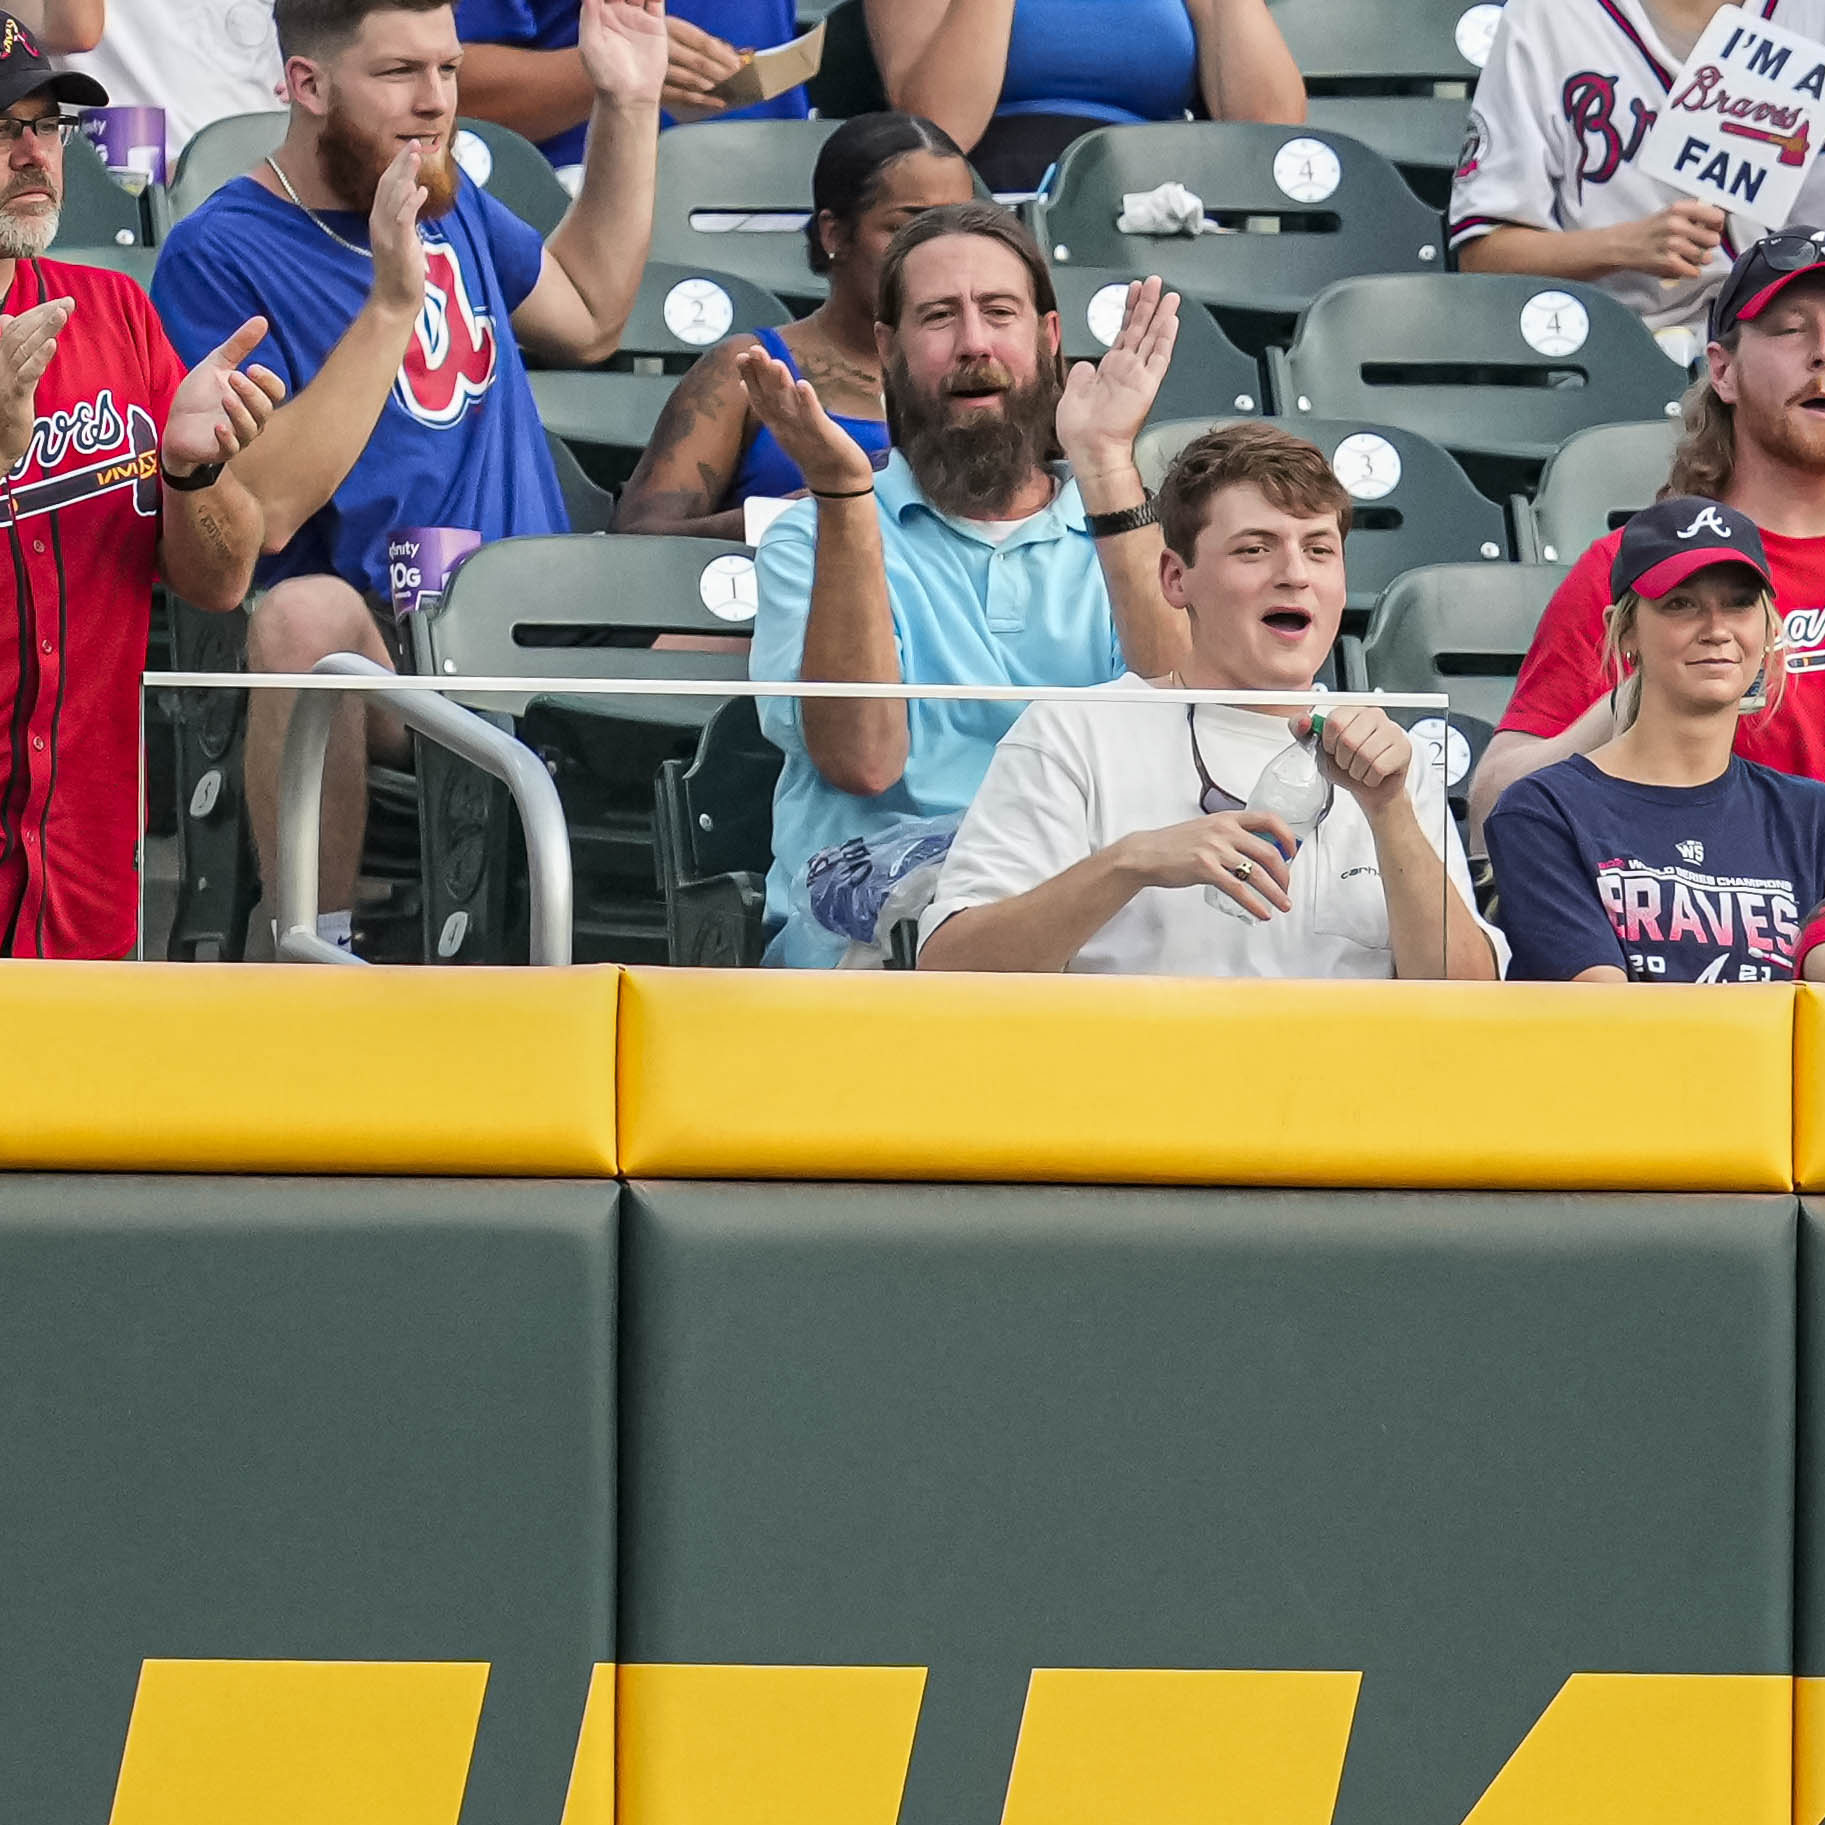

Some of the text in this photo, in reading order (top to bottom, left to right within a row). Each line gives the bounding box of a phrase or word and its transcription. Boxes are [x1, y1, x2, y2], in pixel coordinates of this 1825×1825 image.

[1720, 27, 1794, 81] I'M
[1671, 65, 1803, 130] Braves
[1298, 159, 1313, 183] 4
[1674, 136, 1768, 203] FAN
[692, 299, 707, 323] 2
[1544, 311, 1560, 334] 4
[1361, 453, 1374, 481] 3
[1676, 506, 1732, 539] A
[1428, 743, 1445, 767] 2
[1716, 877, 1794, 892] CHAMPIONS
[1596, 874, 1800, 958] BRAVES
